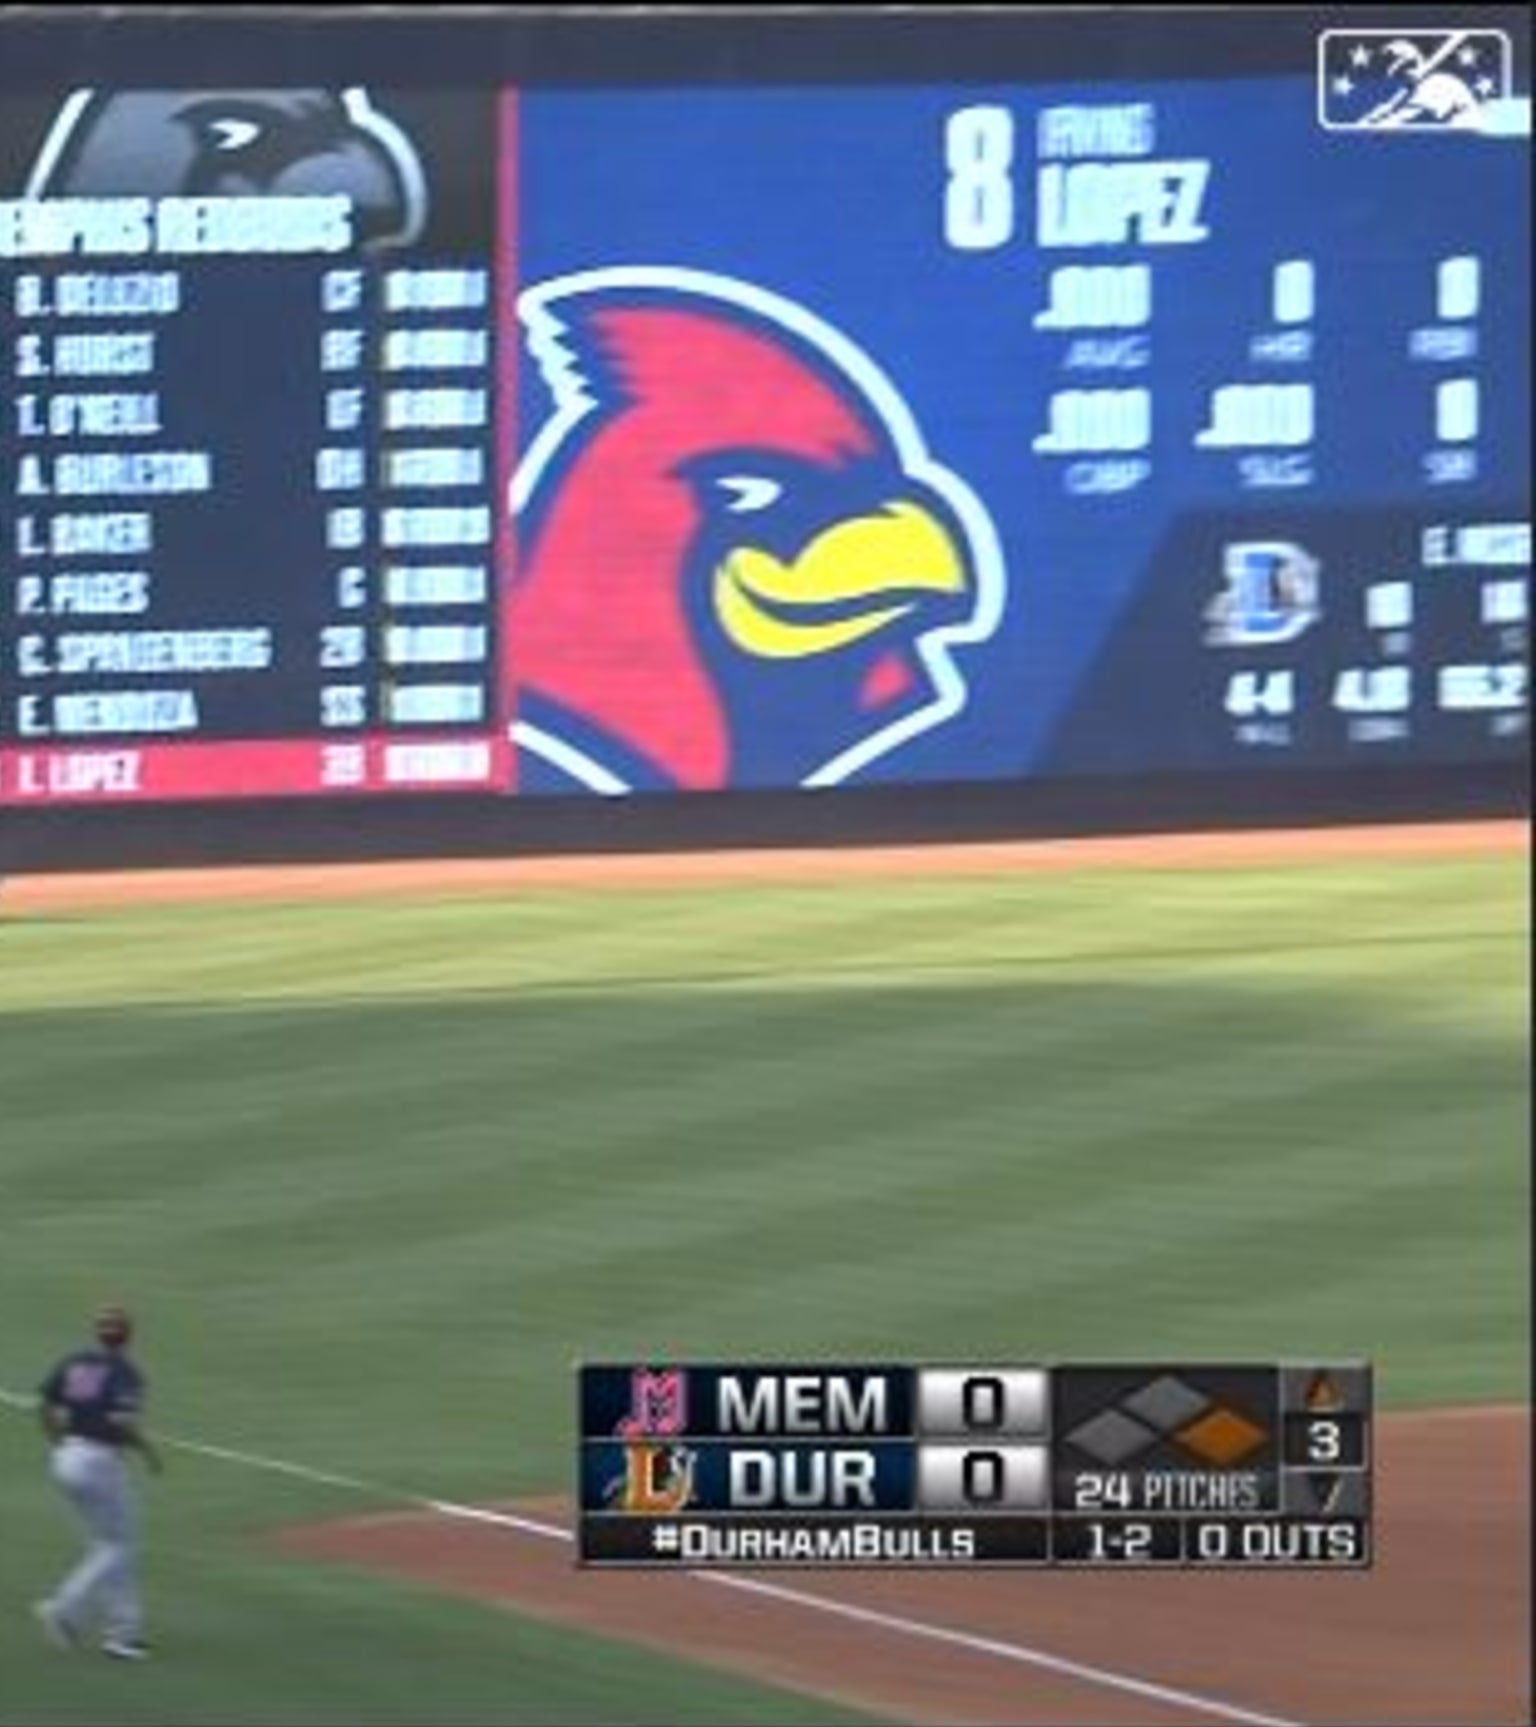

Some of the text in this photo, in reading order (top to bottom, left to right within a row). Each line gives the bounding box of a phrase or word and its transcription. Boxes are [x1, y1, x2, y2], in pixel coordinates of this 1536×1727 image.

[943, 106, 1014, 251] 8
[1036, 160, 1211, 247] LOPEZ
[48, 750, 143, 794] LOPEZ
